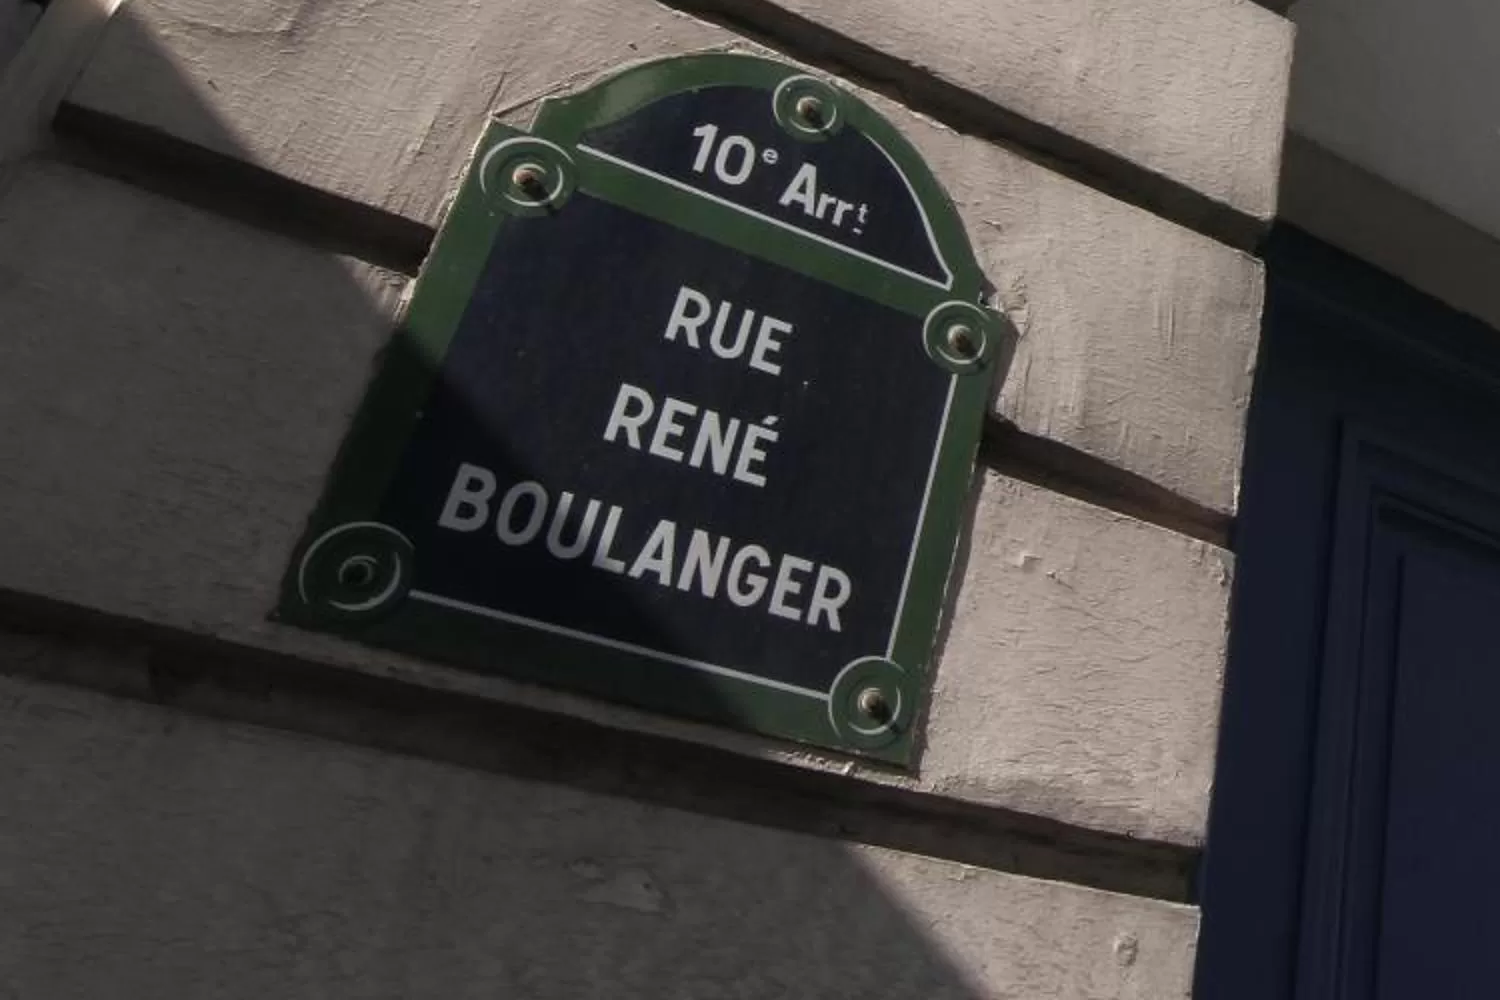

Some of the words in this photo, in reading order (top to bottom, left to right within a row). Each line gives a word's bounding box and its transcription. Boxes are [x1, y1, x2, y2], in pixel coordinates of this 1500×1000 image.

[664, 286, 793, 375] RUE
[603, 384, 780, 488] RENÉ
[437, 463, 852, 632] BOULANGER
